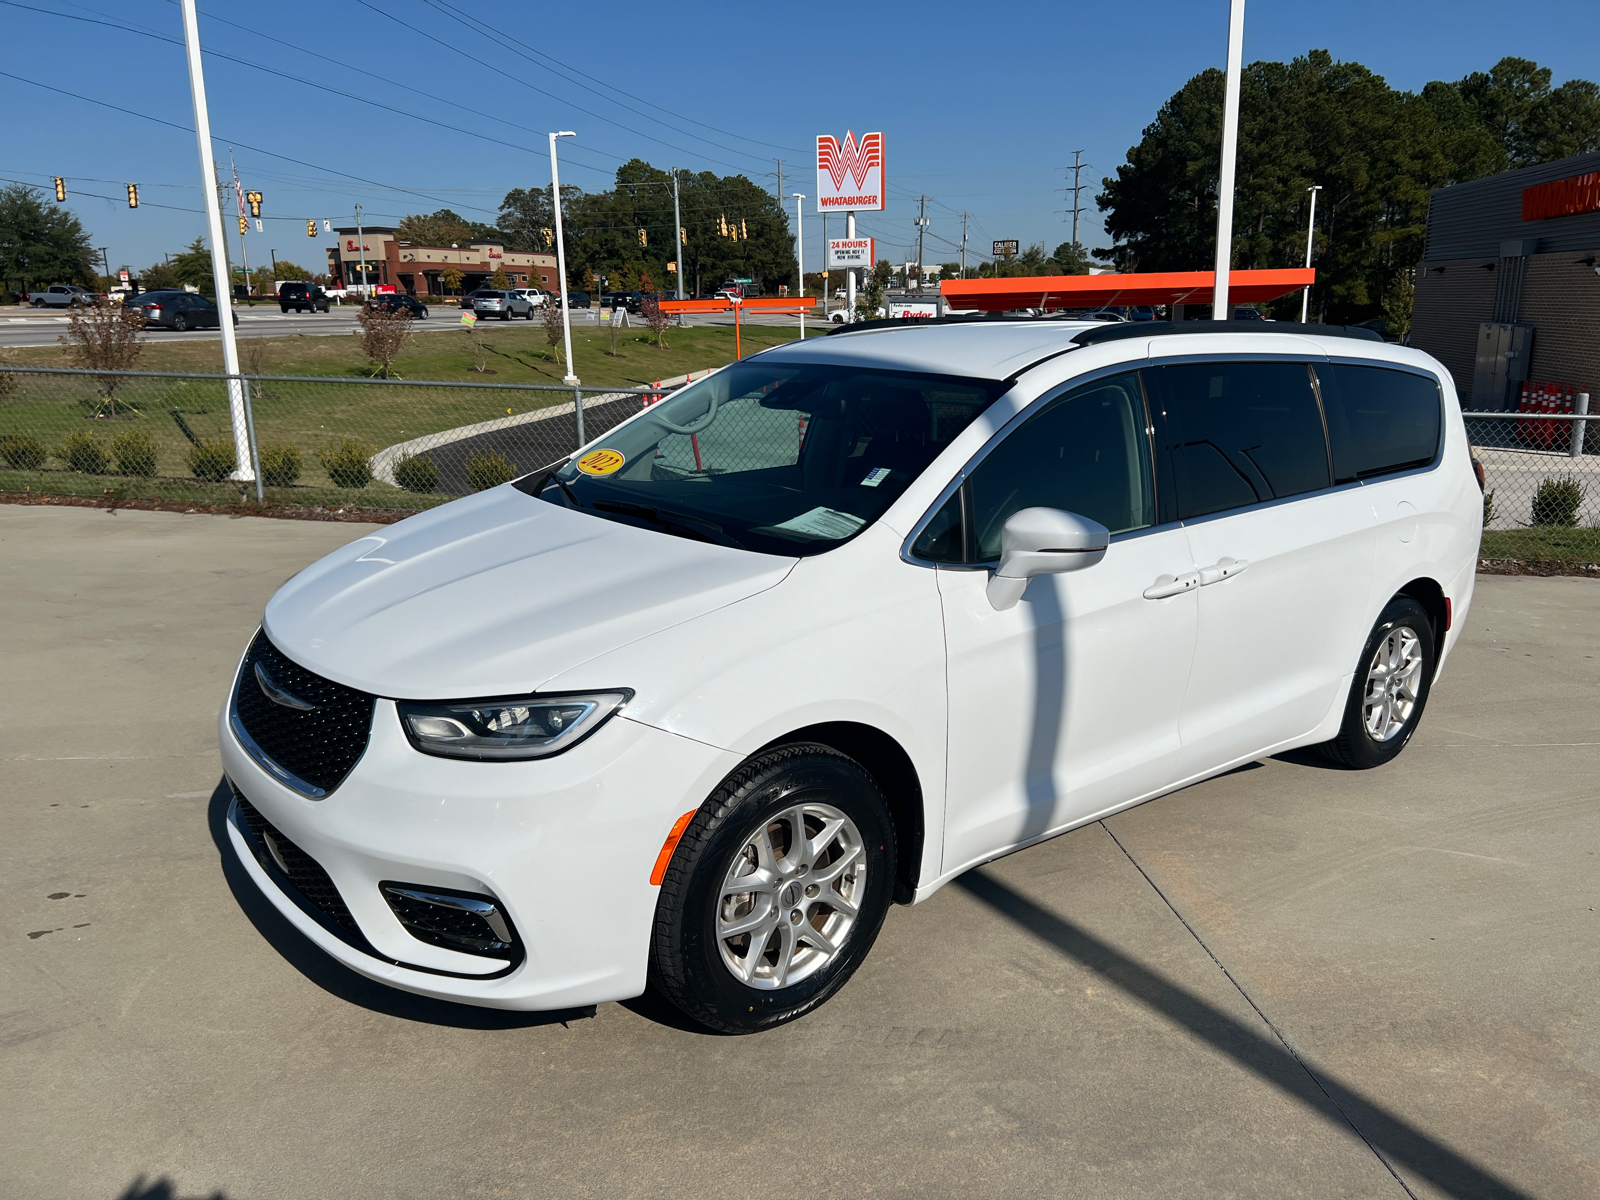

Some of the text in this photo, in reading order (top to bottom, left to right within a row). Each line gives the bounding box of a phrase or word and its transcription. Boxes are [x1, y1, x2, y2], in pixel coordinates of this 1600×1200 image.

[820, 195, 878, 207] WHATABURGER
[831, 240, 868, 249] 24 HOURS
[580, 452, 620, 472] 2022
